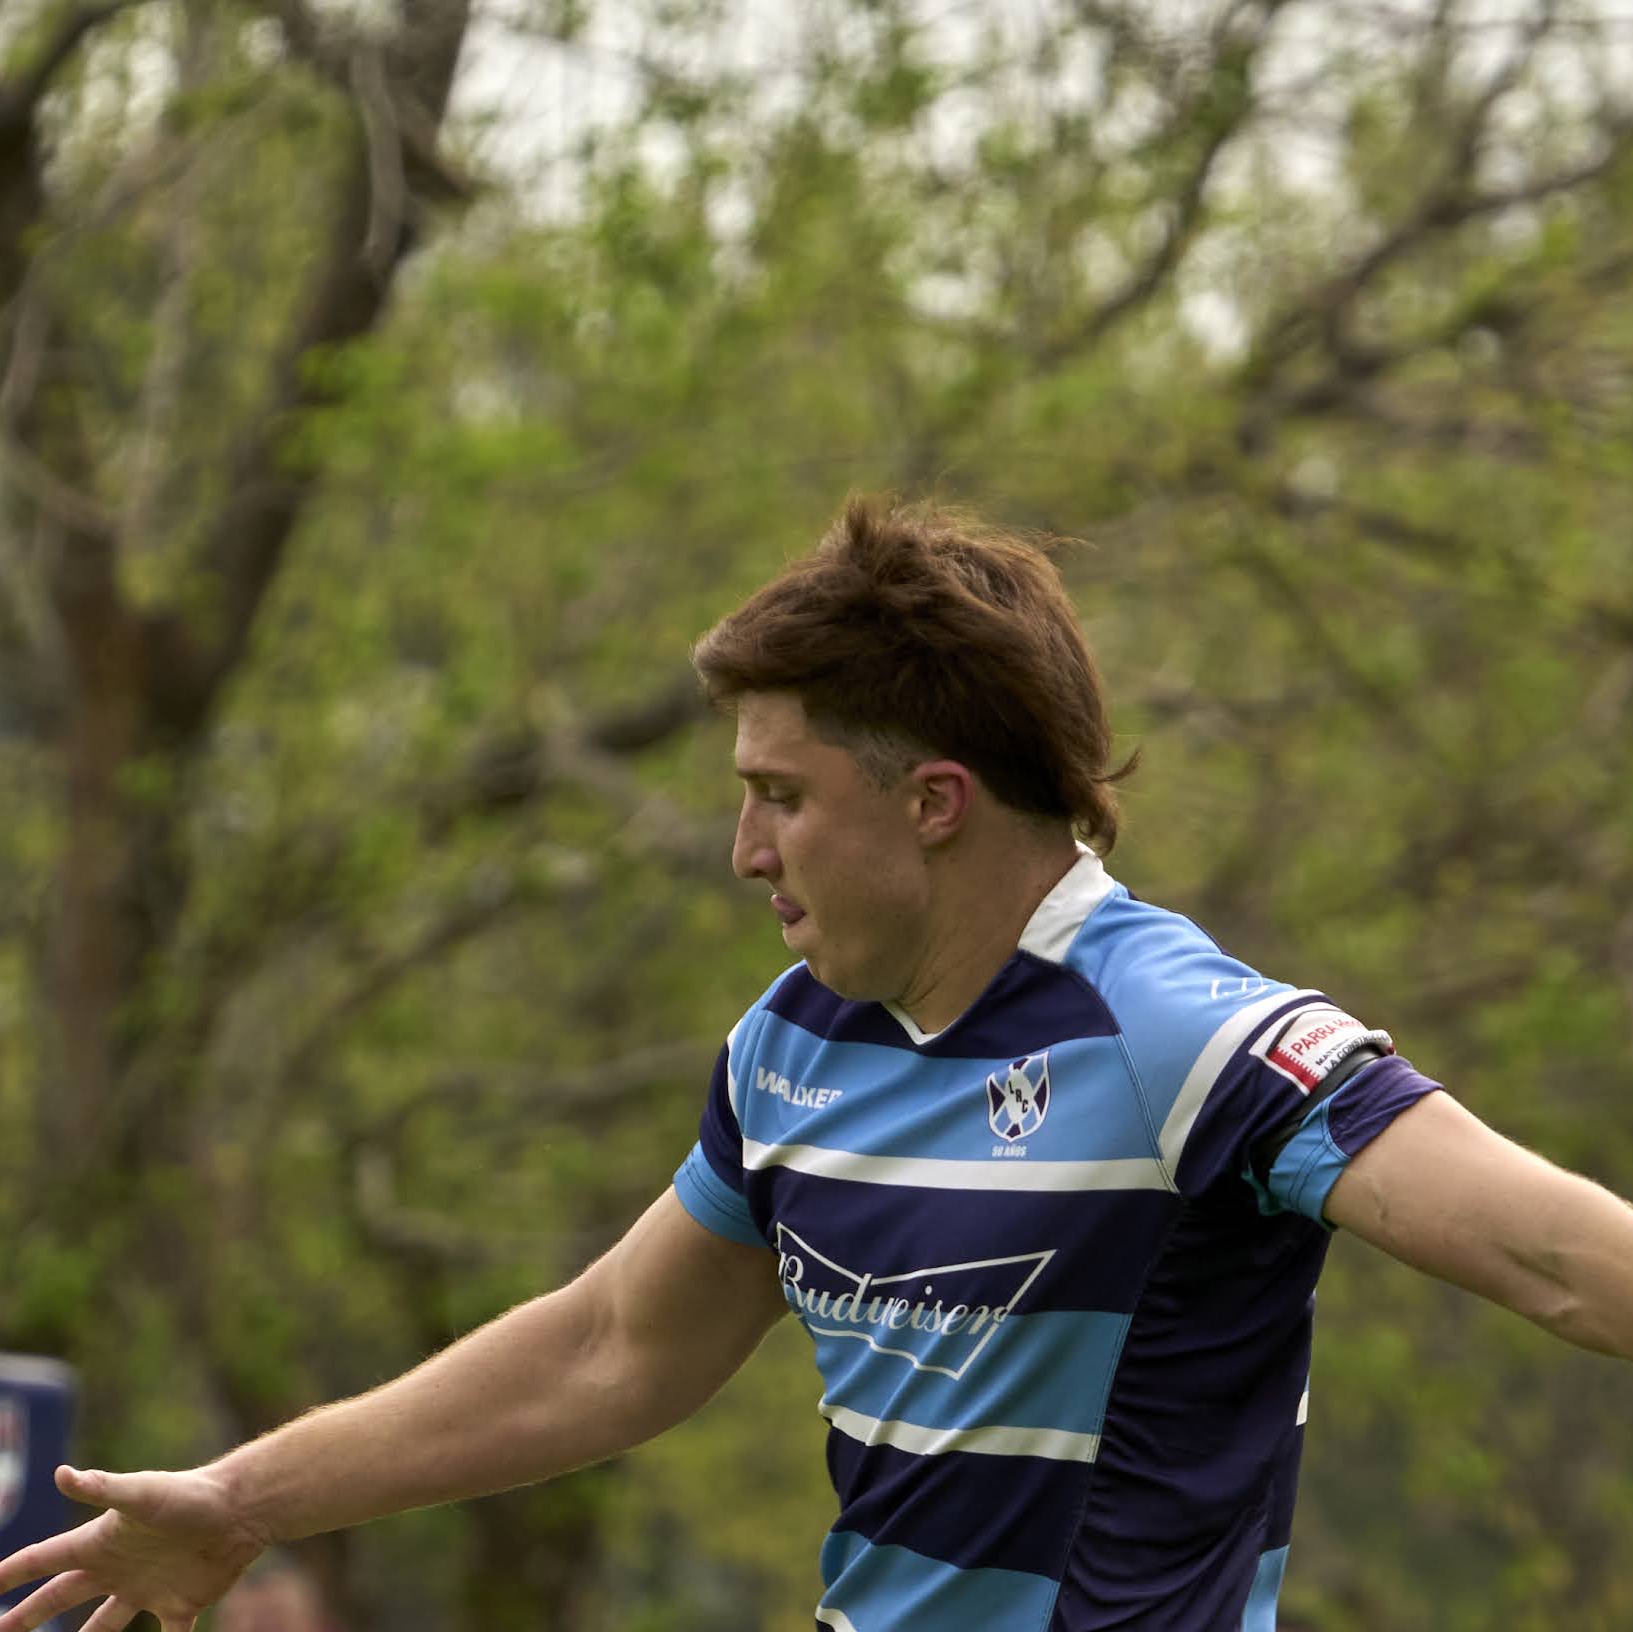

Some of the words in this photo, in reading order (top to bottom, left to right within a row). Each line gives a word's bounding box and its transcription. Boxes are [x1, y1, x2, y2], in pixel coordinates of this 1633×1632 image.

[1291, 1024, 1337, 1056] PARRA
[756, 1065, 843, 1110] WALKER
[1008, 1080, 1029, 1114] LRC
[777, 1252, 1009, 1336] Budweiser
